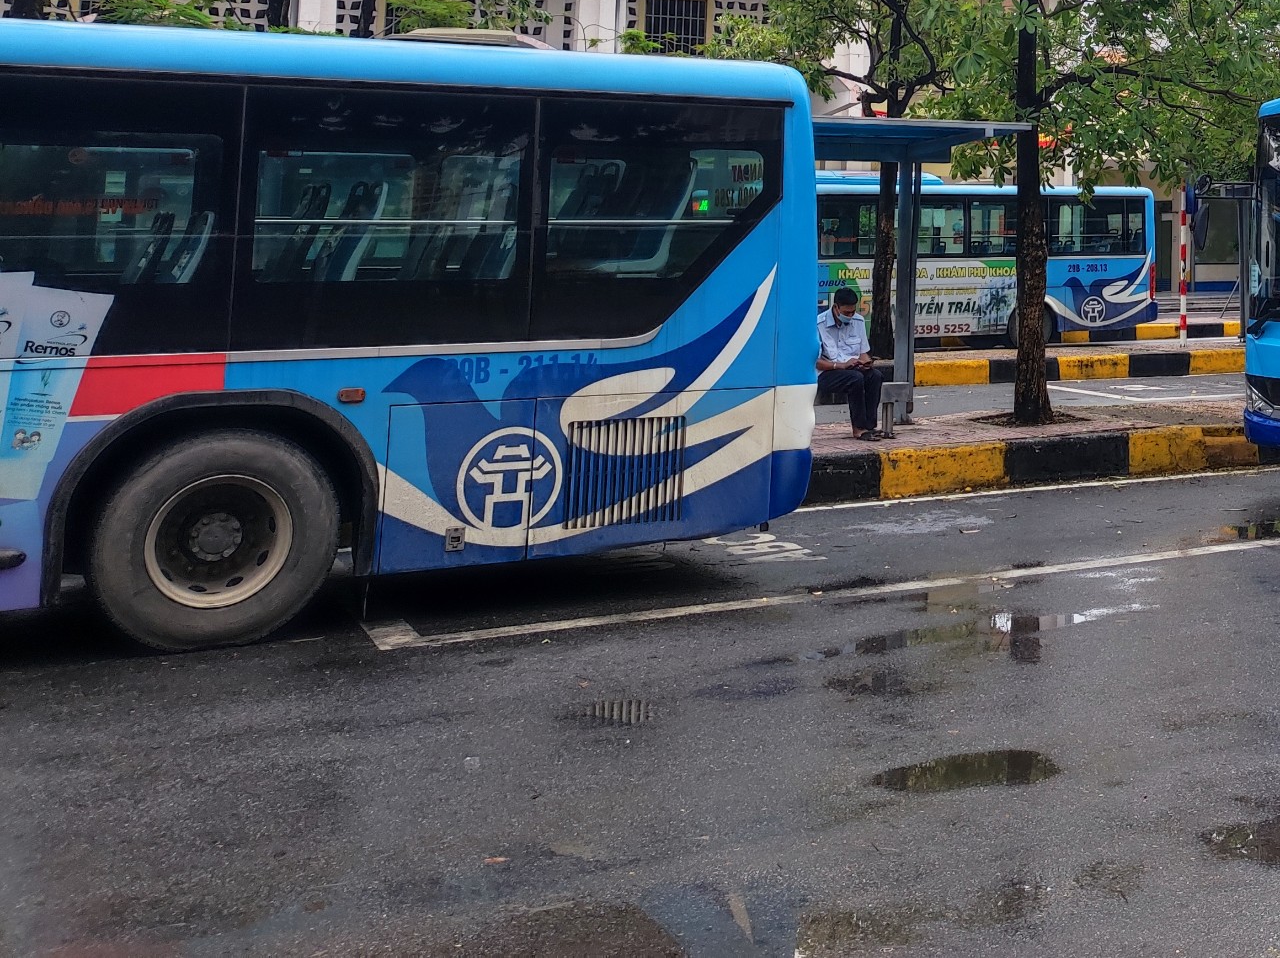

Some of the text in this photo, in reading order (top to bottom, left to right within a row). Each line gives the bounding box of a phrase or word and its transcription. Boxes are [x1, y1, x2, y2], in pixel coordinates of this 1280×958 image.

[838, 266, 870, 280] KHÁM
[936, 265, 967, 279] KHÁM
[968, 267, 988, 280] PHỤ
[943, 323, 971, 334] 5252
[23, 340, 76, 357] Remos
